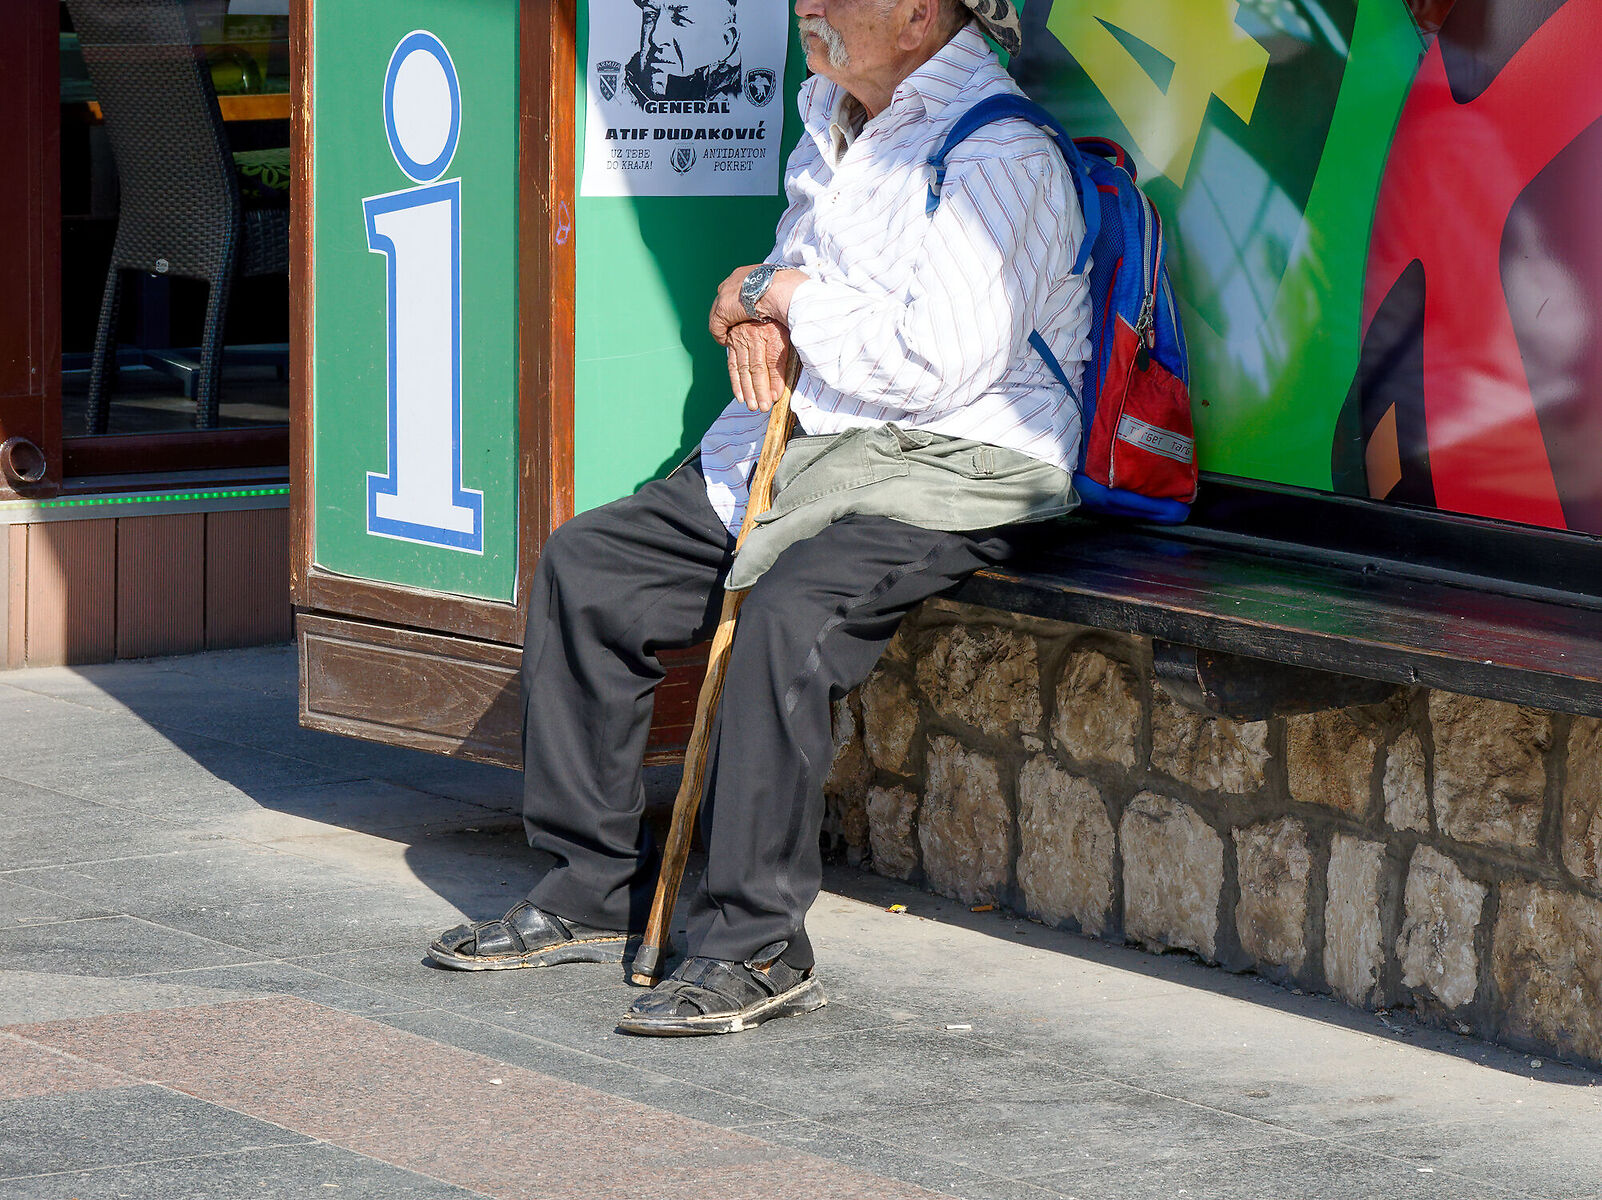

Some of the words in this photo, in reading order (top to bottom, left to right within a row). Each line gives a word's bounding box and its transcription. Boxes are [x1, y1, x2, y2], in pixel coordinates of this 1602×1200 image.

[643, 100, 730, 113] GENERAL
[604, 128, 650, 140] ATIF
[653, 121, 766, 140] DUDAKOVIĆ
[610, 149, 623, 159] UZ
[625, 149, 651, 159] TEBE
[703, 148, 767, 159] ANTIDAYTON
[606, 160, 619, 170] DO
[621, 160, 653, 170] KRAJA!
[713, 160, 754, 172] POKRET
